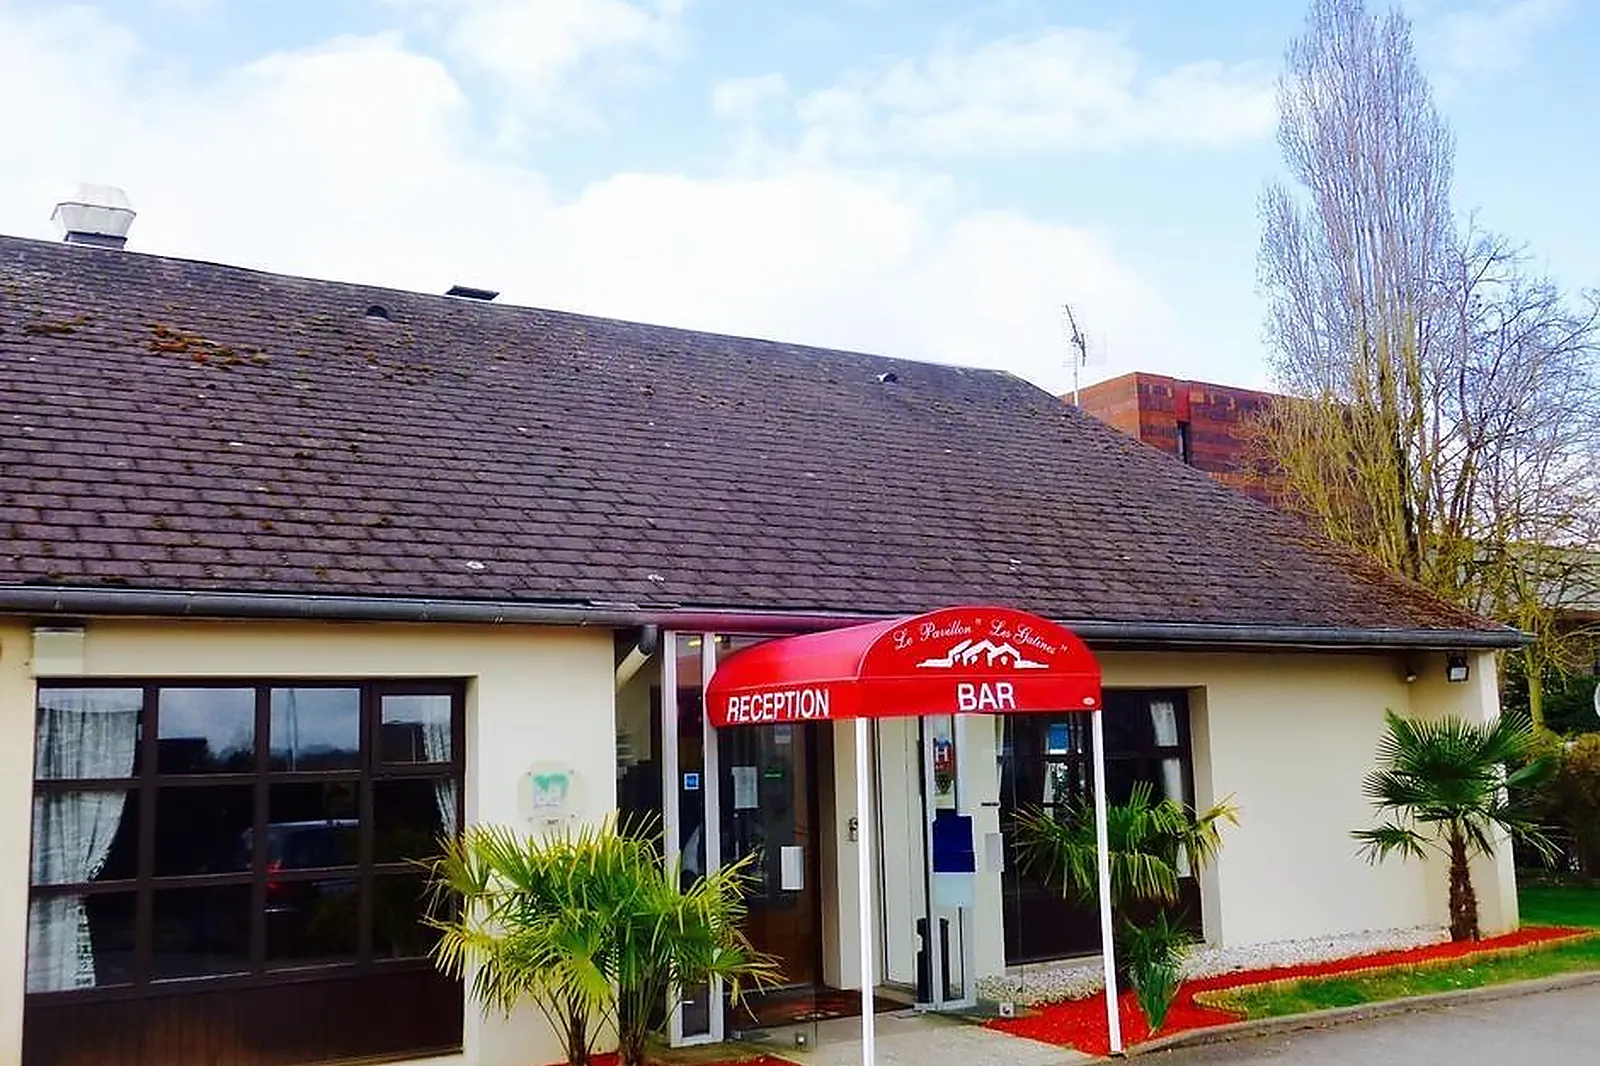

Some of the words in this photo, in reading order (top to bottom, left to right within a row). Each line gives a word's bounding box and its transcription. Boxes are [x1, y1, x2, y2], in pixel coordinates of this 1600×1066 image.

[893, 628, 914, 651] Le
[726, 688, 829, 723] RECEPTION
[957, 682, 1017, 712] BAR
